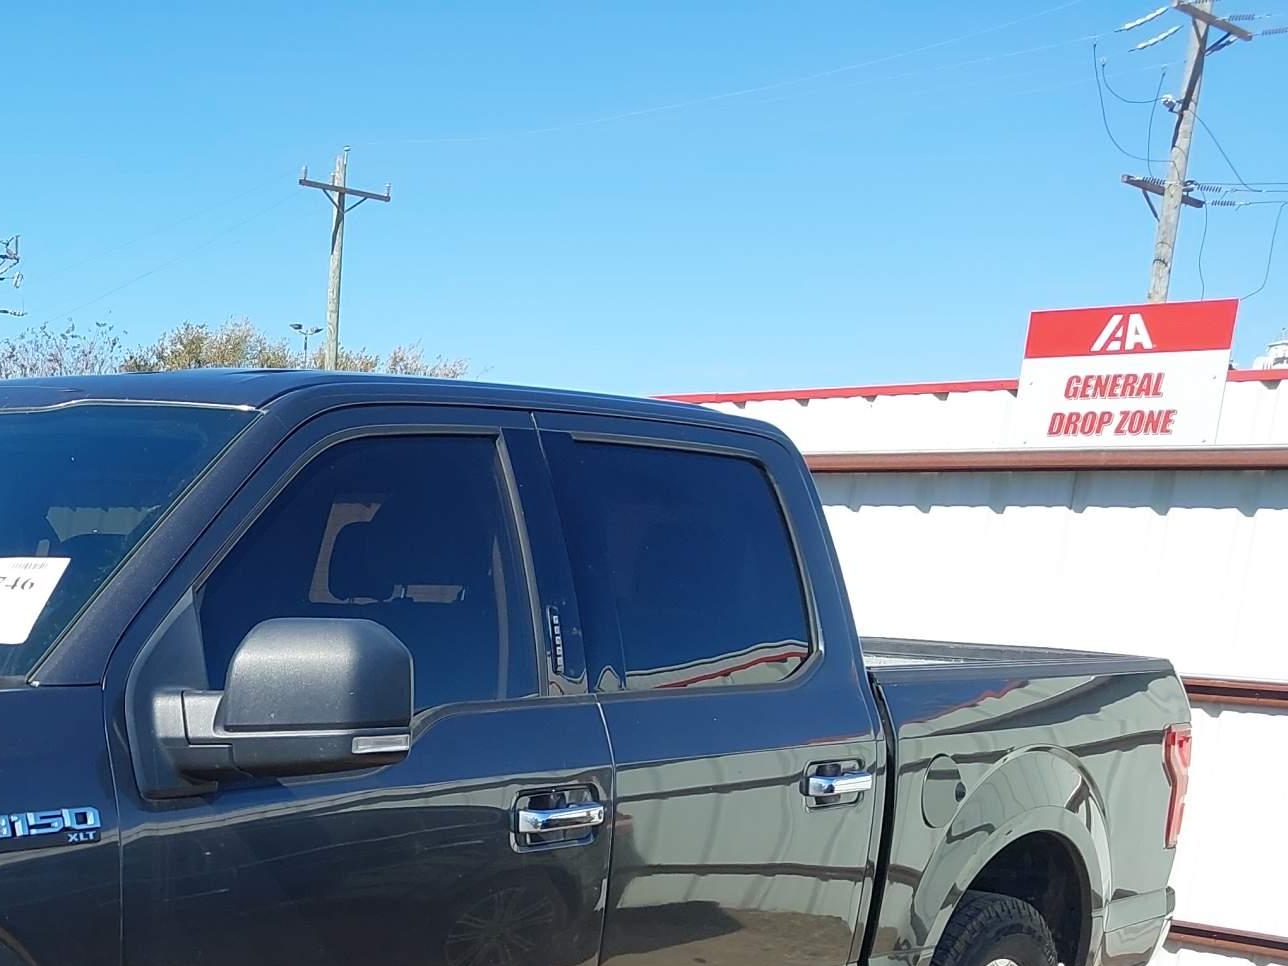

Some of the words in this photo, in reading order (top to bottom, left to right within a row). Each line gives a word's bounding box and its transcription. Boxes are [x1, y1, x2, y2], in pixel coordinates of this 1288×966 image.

[1064, 373, 1166, 400] GENERAL
[1047, 411, 1114, 437] DROP
[1114, 409, 1177, 436] ZONE
[68, 831, 97, 843] XLT
